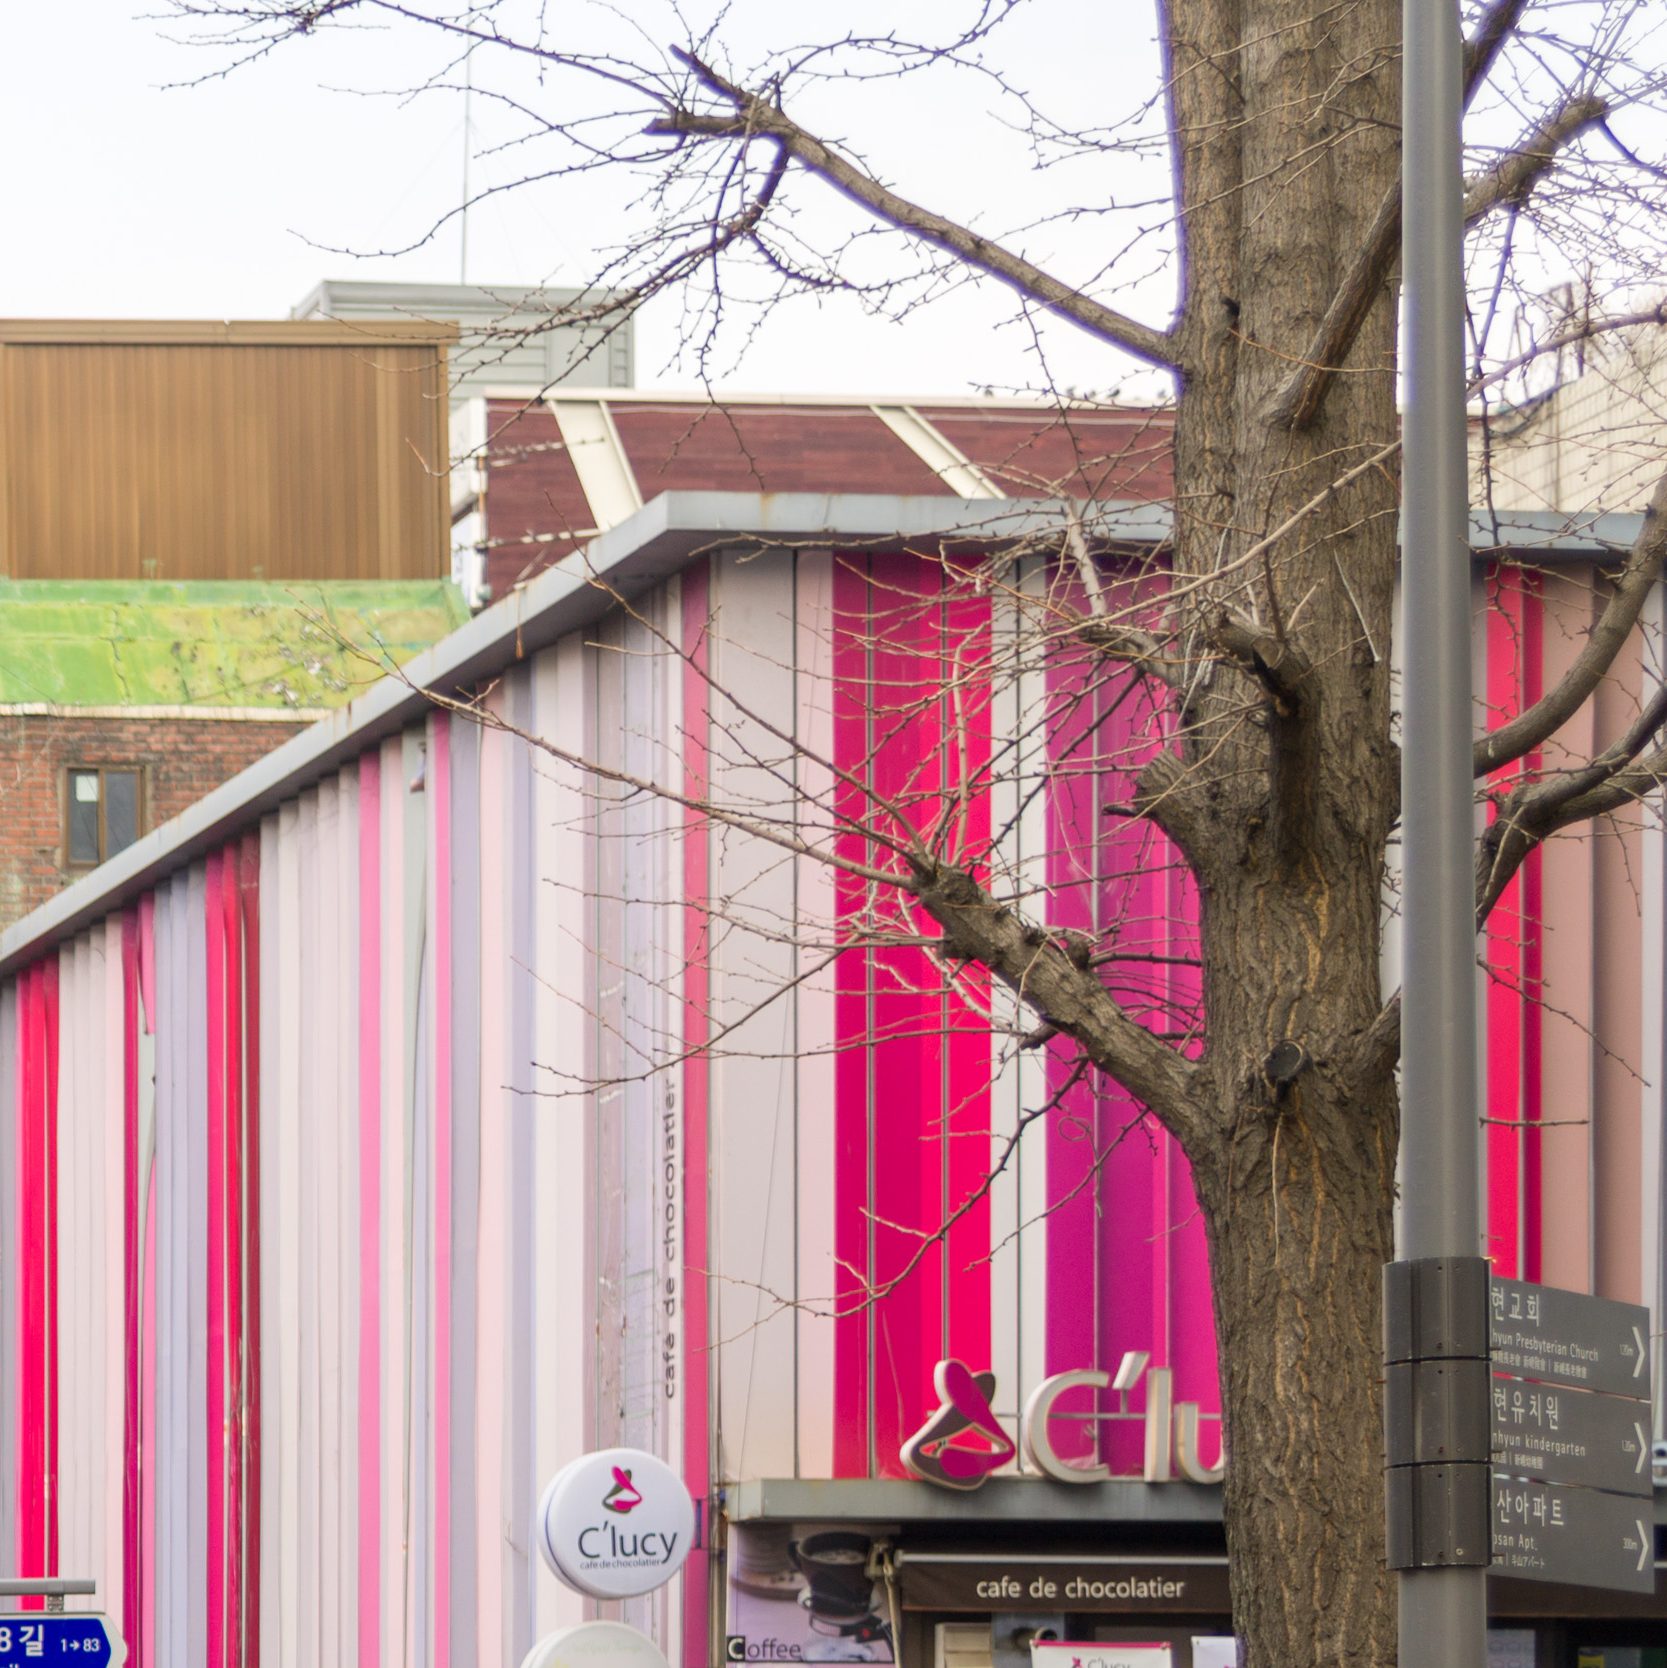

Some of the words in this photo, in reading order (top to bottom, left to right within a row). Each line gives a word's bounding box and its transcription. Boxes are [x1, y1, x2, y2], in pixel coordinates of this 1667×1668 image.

[1515, 1331, 1567, 1356] Presbyterian
[1569, 1342, 1599, 1363] Church
[1524, 1433, 1586, 1458] kindergarten
[577, 1519, 678, 1565] C'lucy
[1518, 1534, 1538, 1552] Apt.
[579, 1558, 599, 1571] cafe
[599, 1558, 611, 1570] de
[612, 1557, 662, 1570] chocolatier
[976, 1576, 1022, 1599] cafe
[1029, 1576, 1058, 1599] de
[1064, 1574, 1186, 1600] chocolatier
[82, 1638, 100, 1653] 83
[727, 1636, 802, 1662] Coffee
